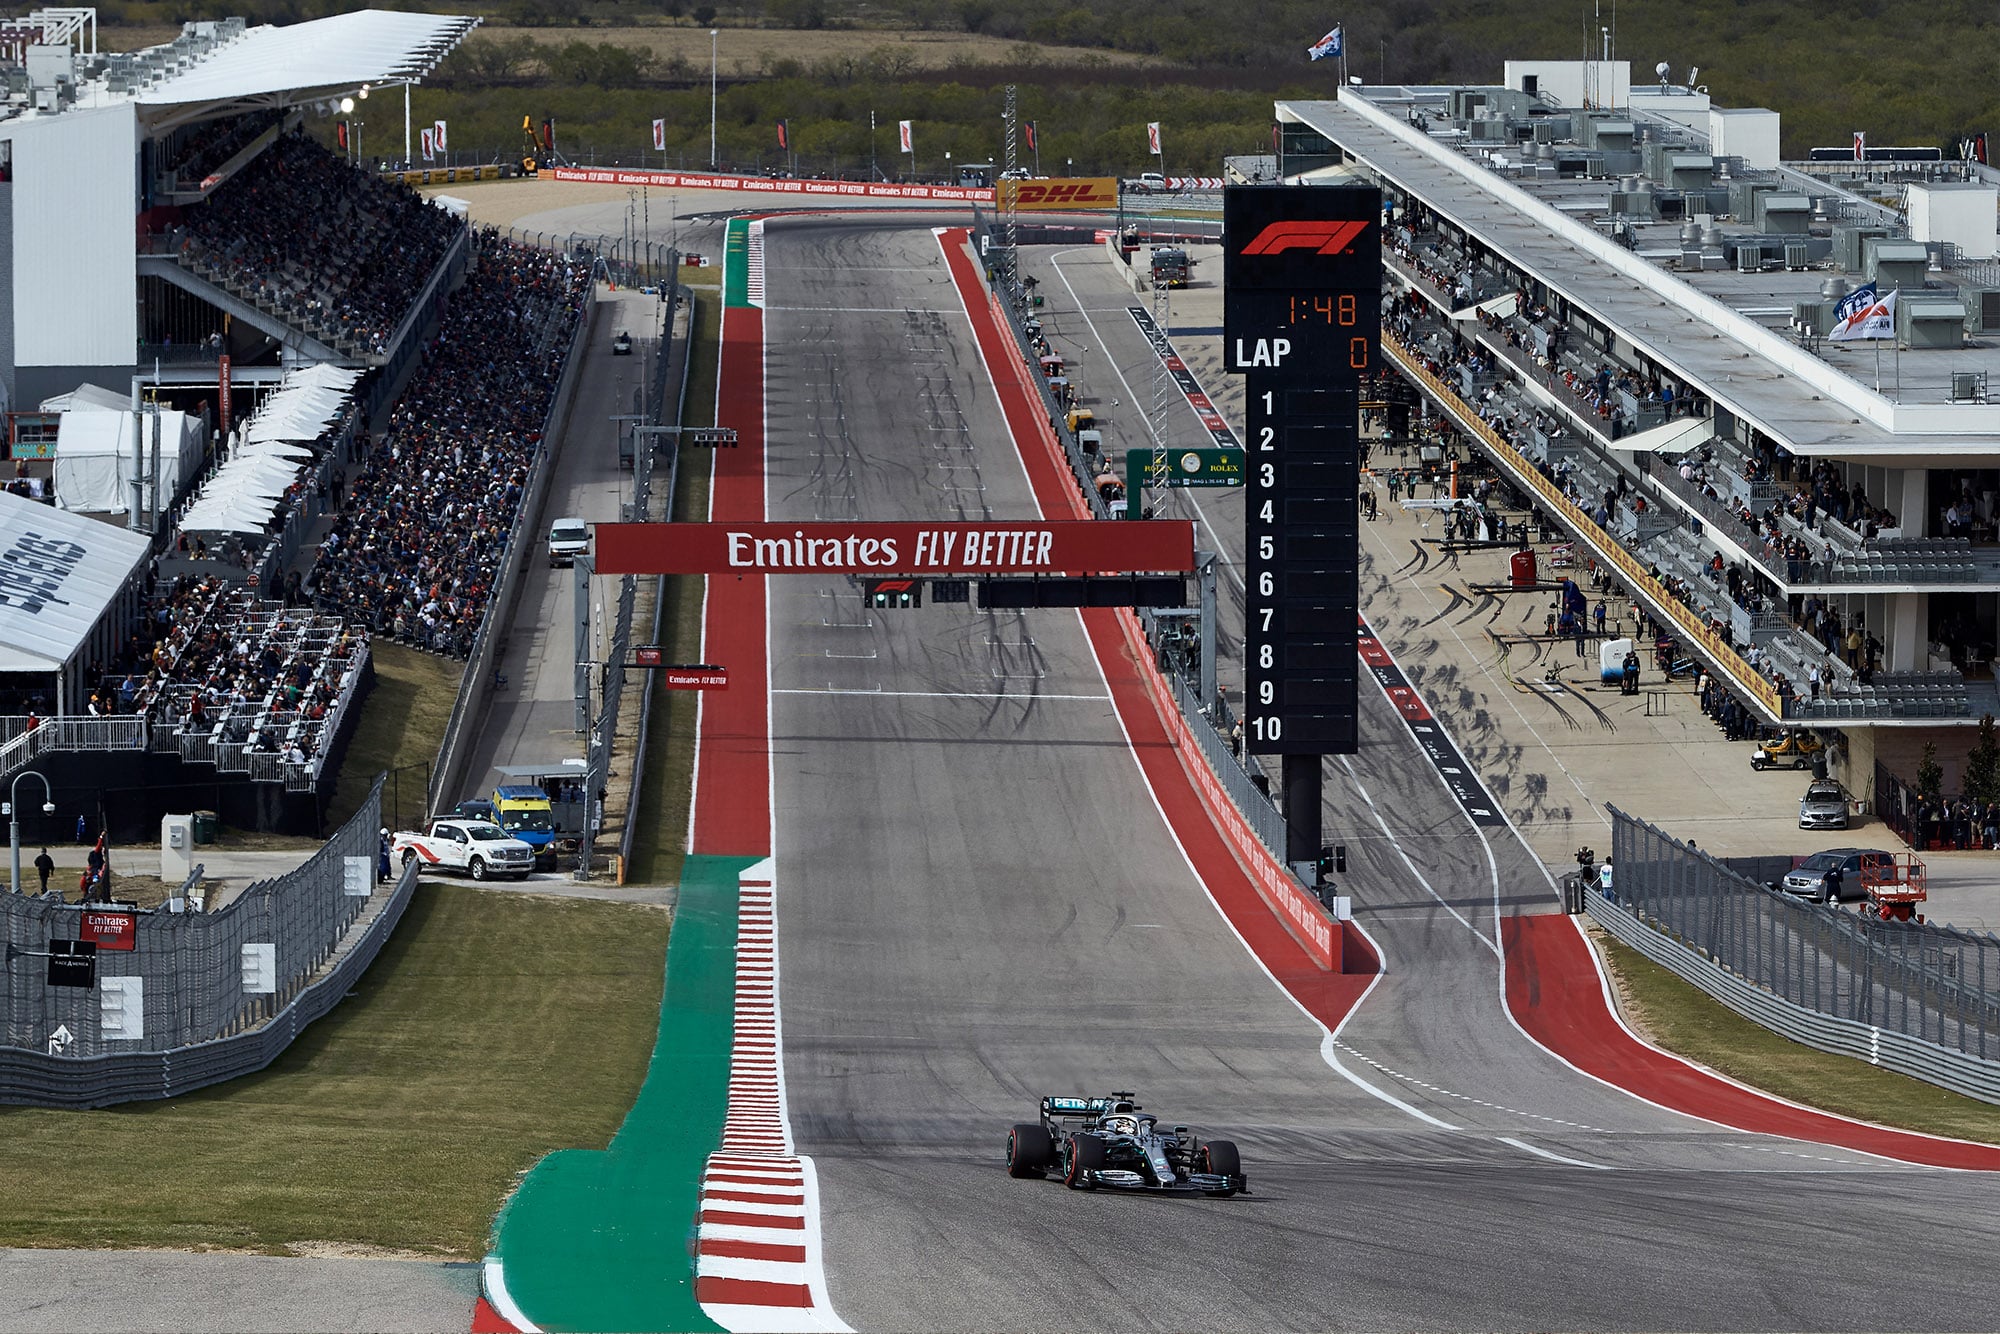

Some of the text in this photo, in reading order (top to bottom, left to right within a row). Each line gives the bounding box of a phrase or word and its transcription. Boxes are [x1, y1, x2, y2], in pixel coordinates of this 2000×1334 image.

[556, 170, 587, 180] Emirates
[618, 173, 649, 183] Emirates
[680, 177, 711, 187] Emirates
[743, 180, 774, 189] Emirates
[806, 183, 837, 193] Emirates
[869, 186, 900, 195] Emirates
[932, 189, 964, 198] Emirates
[1016, 184, 1099, 203] DHL
[1290, 295, 1356, 326] 1:48
[1236, 337, 1367, 368] LAP 0
[1261, 391, 1272, 415] 1
[1260, 427, 1274, 451] 2
[1210, 464, 1239, 472] ROLEX
[1260, 463, 1275, 488] 3
[1259, 500, 1274, 524] 4
[726, 530, 1053, 568] Emirates FLY BETTER
[1259, 536, 1274, 560] 5
[1259, 572, 1274, 596] 6
[1259, 608, 1274, 632] 7
[1259, 645, 1274, 669] 8
[668, 675, 701, 685] Emirates
[1259, 681, 1274, 705] 9
[1252, 717, 1281, 741] 10
[88, 915, 129, 926] Emirates
